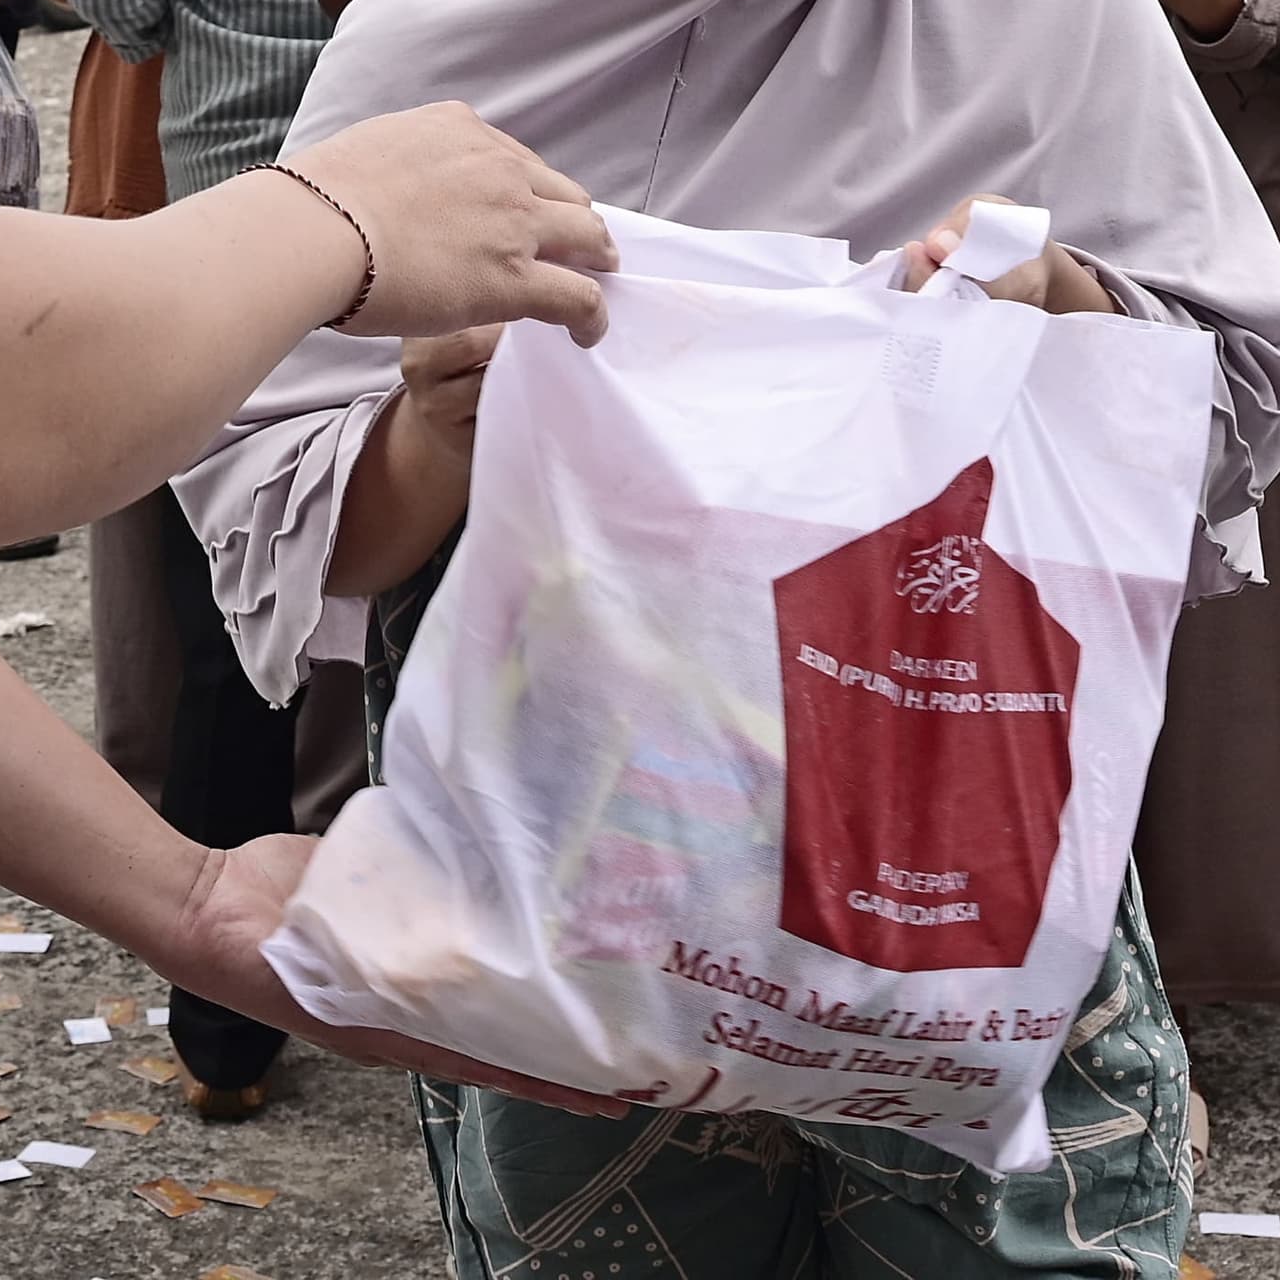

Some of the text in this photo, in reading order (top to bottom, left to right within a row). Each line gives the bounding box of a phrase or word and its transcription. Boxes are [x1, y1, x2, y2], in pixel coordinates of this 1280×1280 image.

[658, 939, 788, 1012] Mohon
[980, 1008, 1005, 1042] &
[703, 1010, 1001, 1091] Selamat Hari Raya
